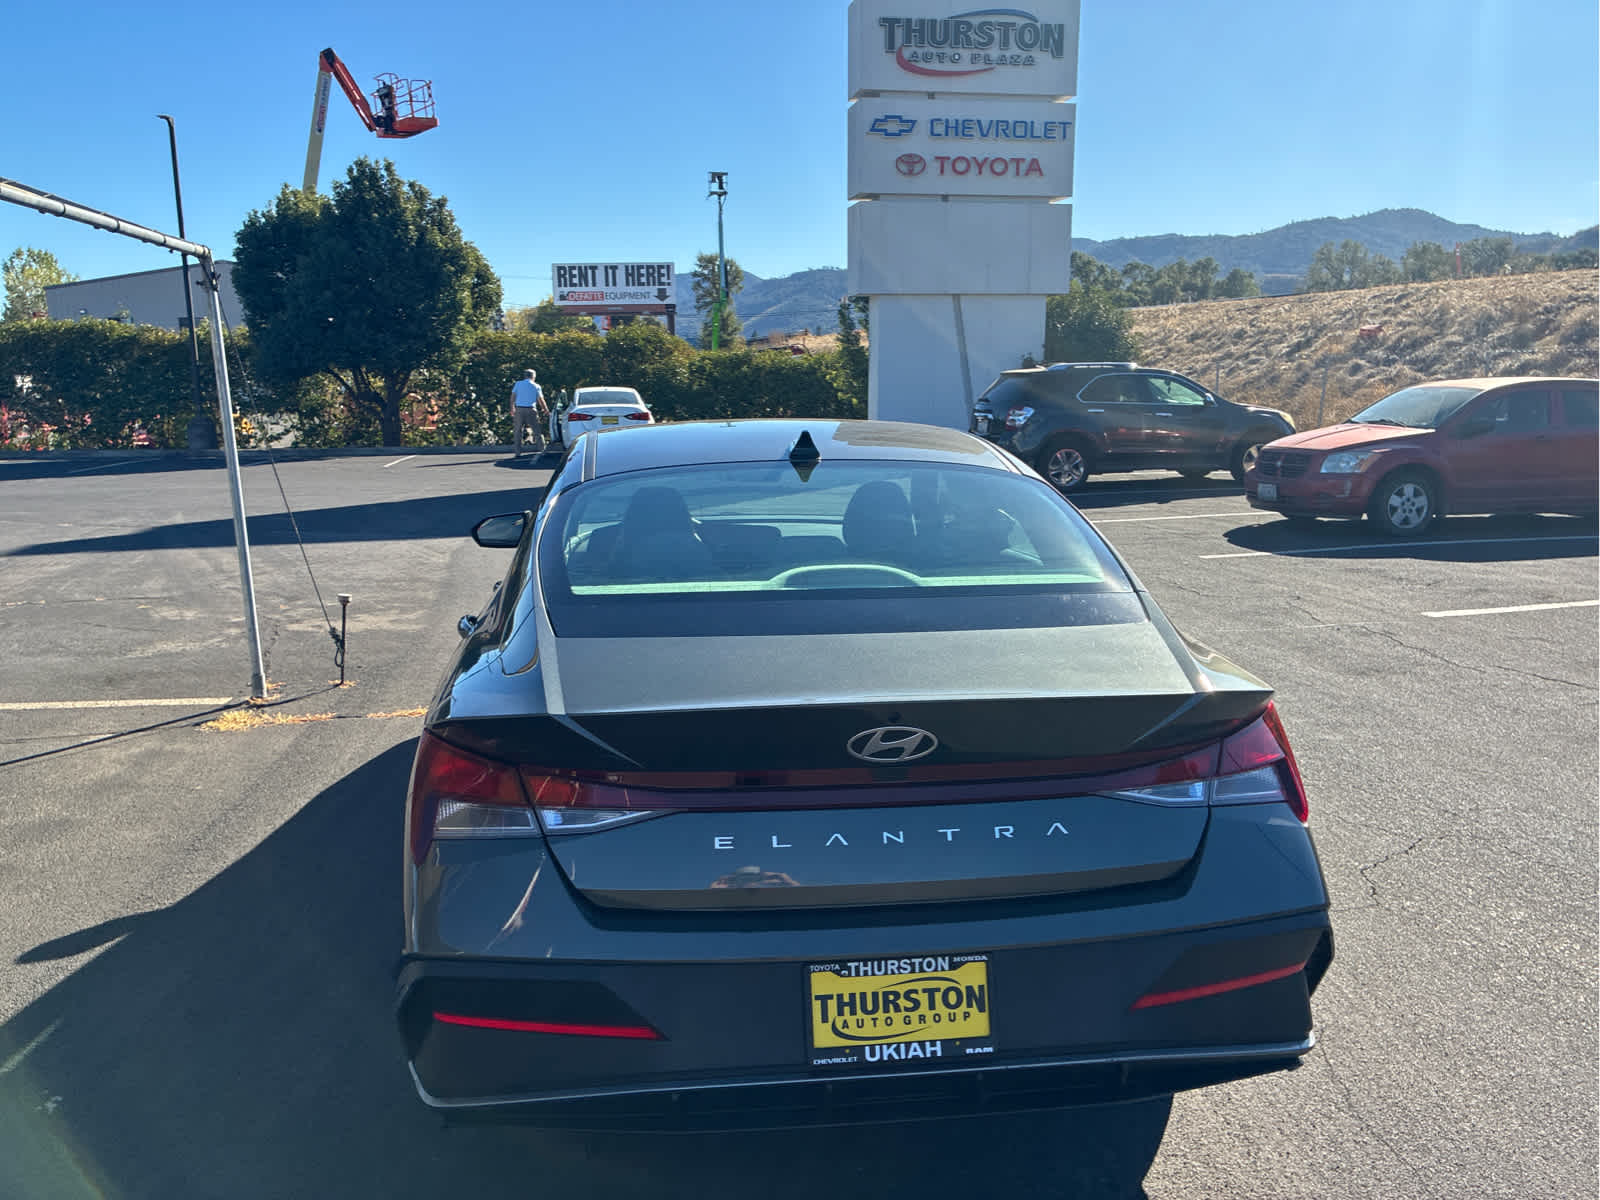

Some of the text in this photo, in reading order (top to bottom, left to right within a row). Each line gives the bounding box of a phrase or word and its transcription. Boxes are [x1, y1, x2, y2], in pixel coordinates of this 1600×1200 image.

[879, 17, 1064, 58] THURSTON
[908, 51, 1035, 66] AUTO PLAZA
[930, 118, 1072, 141] CHEVROLET
[934, 156, 1044, 177] TOYOTA
[557, 264, 671, 288] RENT IT HERE!
[604, 291, 651, 300] EQUIPMENT
[714, 822, 1069, 849] ELANTRA
[810, 964, 840, 972] TOYOTA
[847, 956, 950, 977] THURSTON
[814, 984, 986, 1024] THURSTON
[841, 1012, 972, 1030] AUTO GROUP
[864, 1040, 942, 1062] UKIAH
[965, 1047, 994, 1055] RAM
